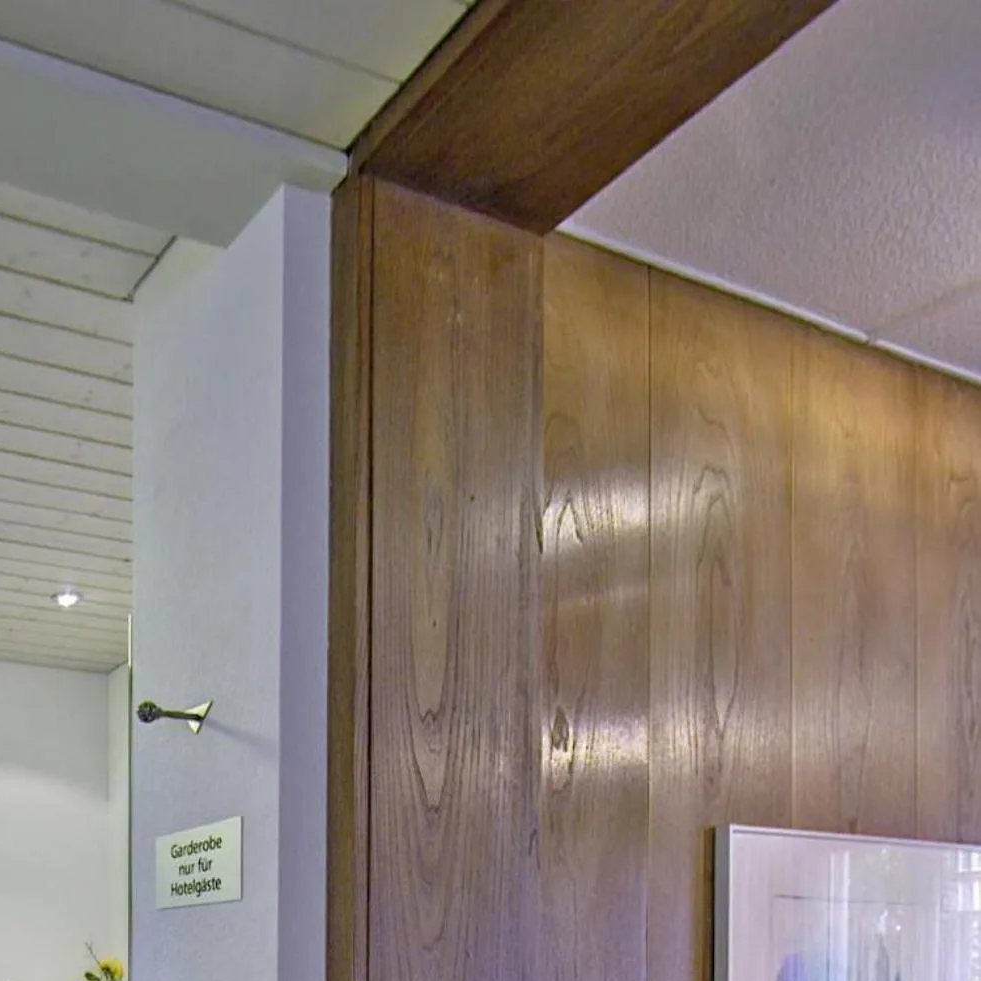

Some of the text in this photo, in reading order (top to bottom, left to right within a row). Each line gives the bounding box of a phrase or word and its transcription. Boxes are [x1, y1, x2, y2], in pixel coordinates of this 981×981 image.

[170, 836, 223, 859] Garderobe
[178, 858, 212, 876] nur für
[170, 877, 222, 897] Hotelgäste
